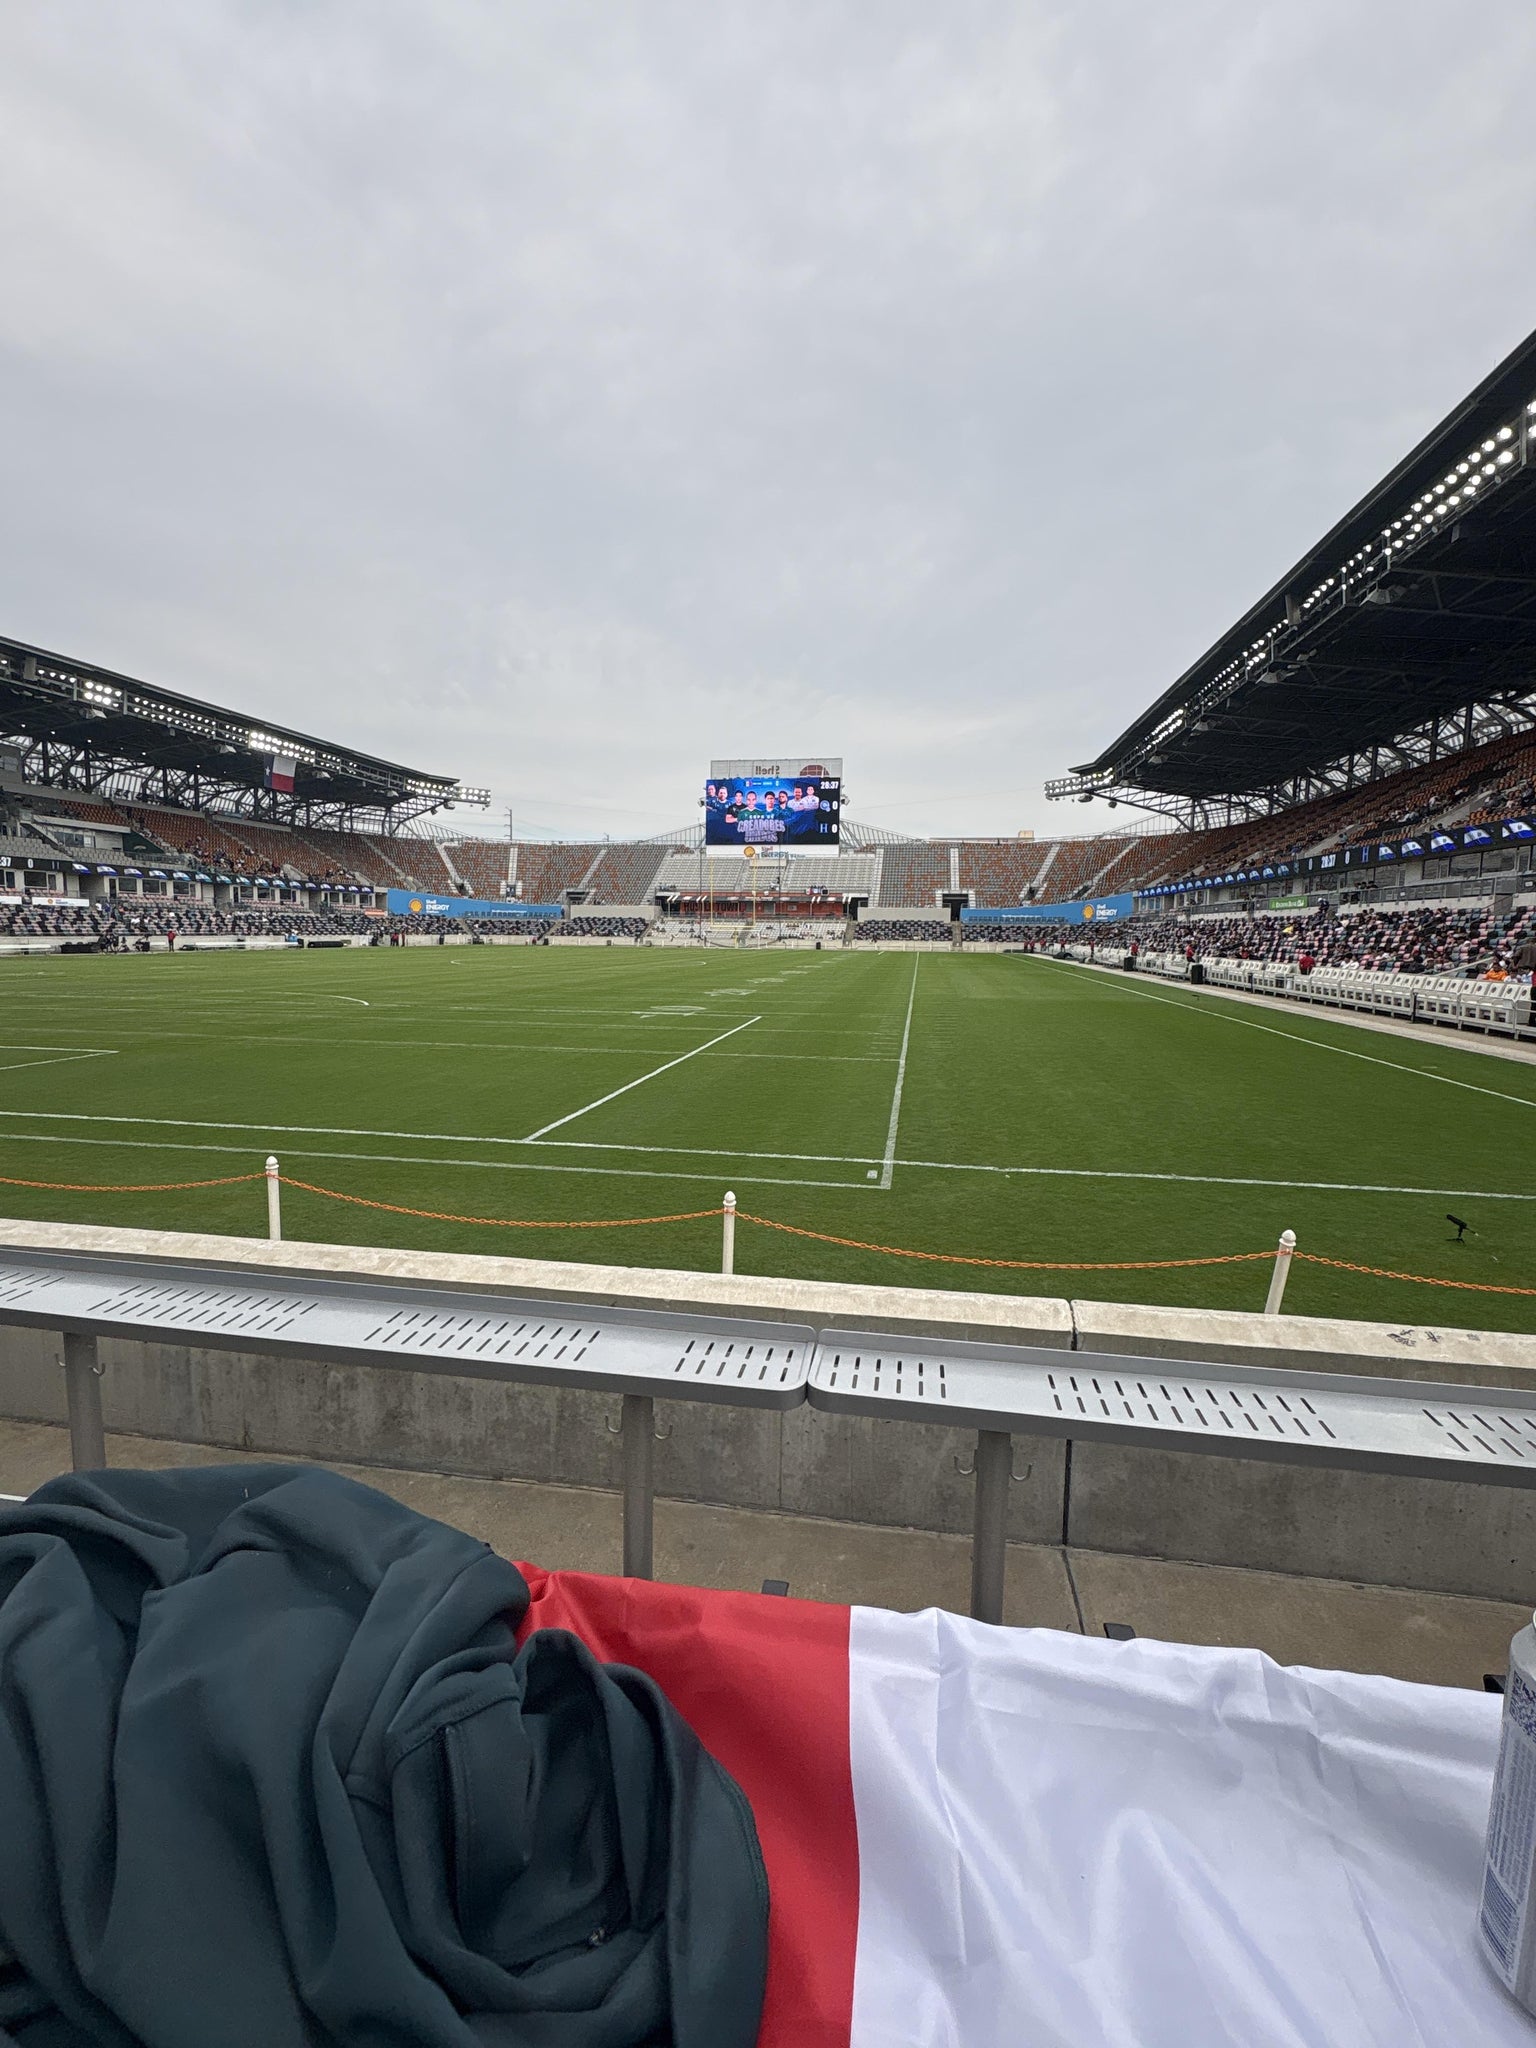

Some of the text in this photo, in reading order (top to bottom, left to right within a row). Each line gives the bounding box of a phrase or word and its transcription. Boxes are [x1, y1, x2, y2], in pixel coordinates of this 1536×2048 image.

[821, 781, 839, 789] 28:37
[832, 800, 838, 810] 0
[820, 823, 838, 833] H 0
[27, 858, 34, 868] 0
[1308, 858, 1313, 871] 0
[1344, 850, 1351, 865] 0
[1361, 846, 1370, 864] H
[1096, 908, 1118, 917] ENERGY
